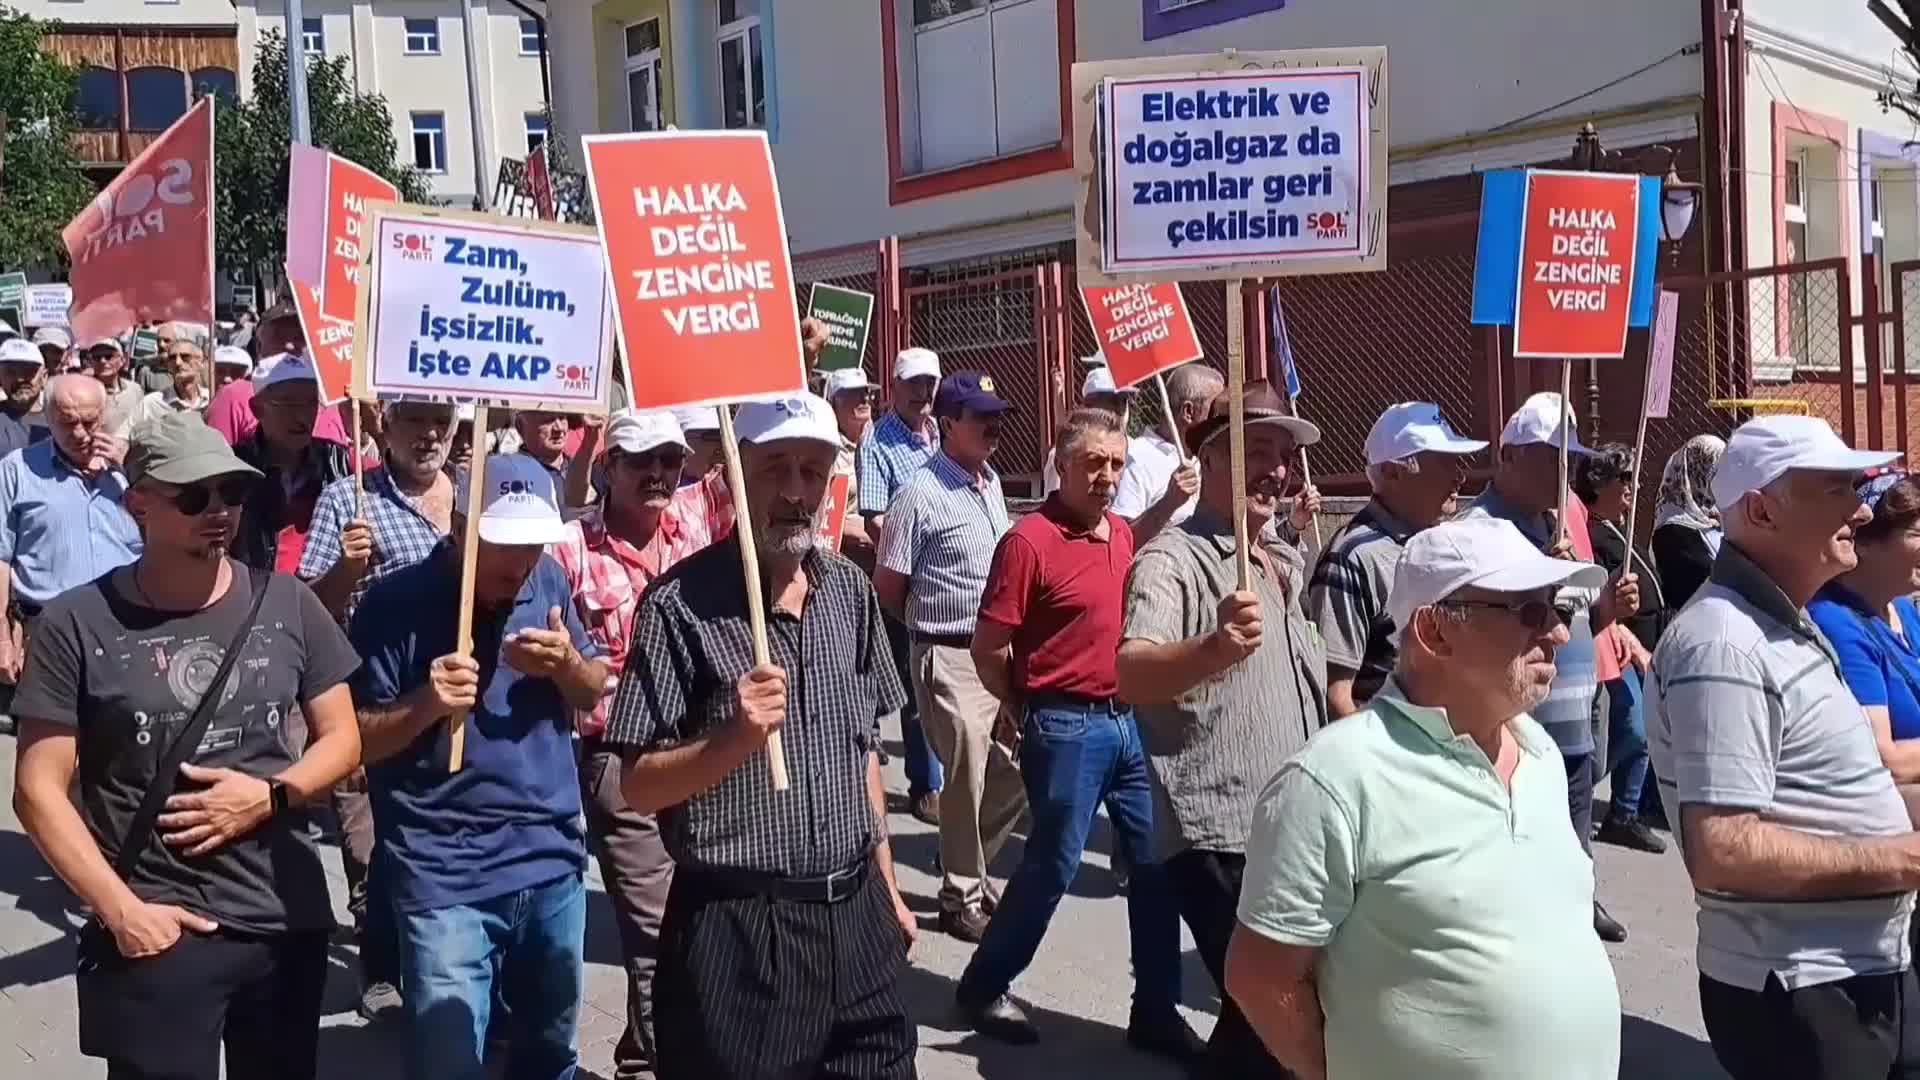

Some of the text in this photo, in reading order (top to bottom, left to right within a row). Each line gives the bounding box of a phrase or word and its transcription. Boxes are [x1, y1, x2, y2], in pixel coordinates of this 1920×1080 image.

[1142, 87, 1331, 123] Elektrik ve
[1123, 126, 1341, 168] doğalgaz da
[633, 183, 747, 216] HALKA
[1133, 166, 1333, 205] zamlar geri
[650, 215, 746, 257] DEĞİL
[1167, 209, 1299, 248] çekilsin
[1307, 211, 1347, 230] SOL
[1548, 207, 1616, 230] HALKA
[393, 233, 432, 251] SOL
[444, 237, 528, 276] Zam,
[1552, 230, 1609, 256] DEĞİL
[632, 255, 774, 300] ZENGİNE
[1534, 258, 1622, 284] ZENGİNE
[460, 276, 575, 317] Zulüm,
[662, 292, 760, 336] VERGİ
[1547, 286, 1607, 311] VERGİ
[420, 304, 544, 345] İşsizlik.
[1105, 303, 1175, 344] ZENGİNE
[408, 340, 551, 381] İşte AKP
[555, 364, 591, 381] SOL
[500, 480, 532, 495] SOL
